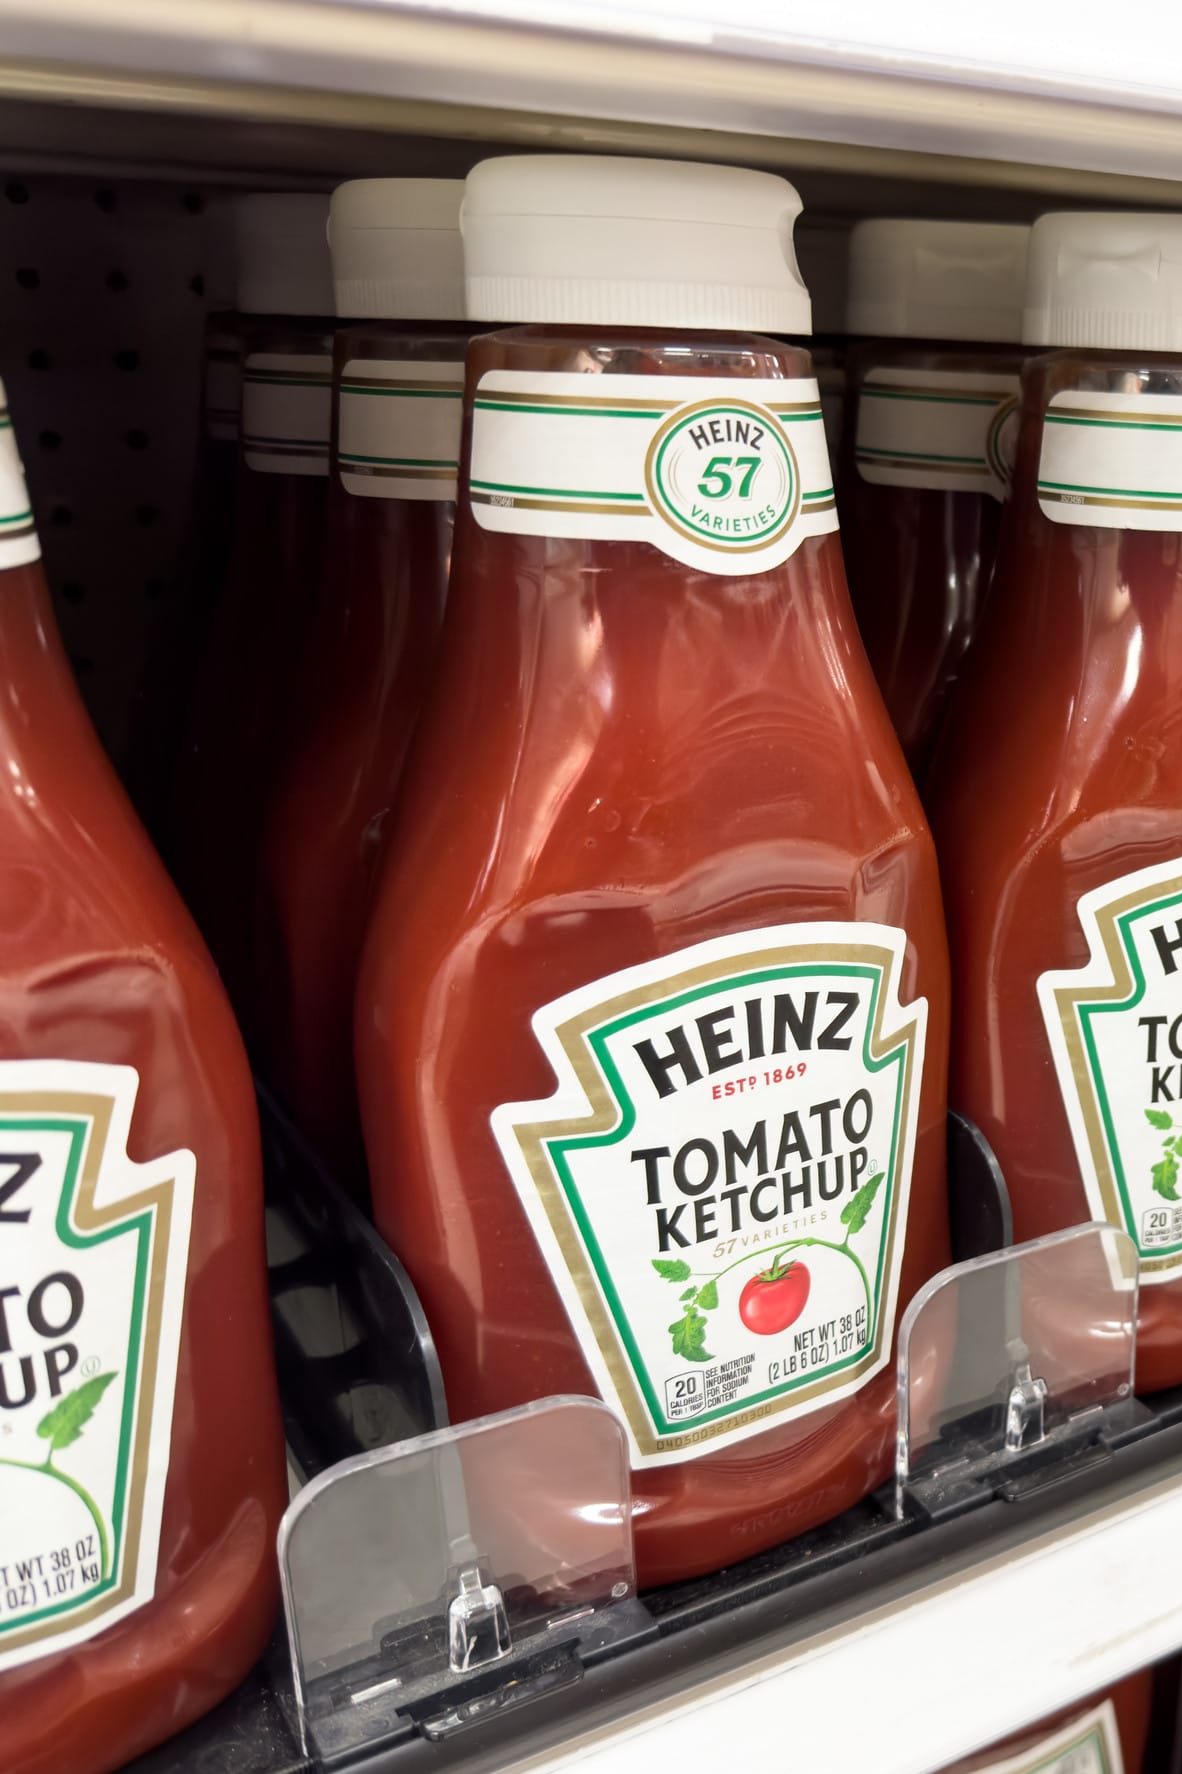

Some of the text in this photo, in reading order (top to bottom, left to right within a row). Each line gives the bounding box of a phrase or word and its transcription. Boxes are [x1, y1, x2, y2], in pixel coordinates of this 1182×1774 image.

[689, 419, 765, 450] HEINZ
[697, 456, 763, 499] 57
[690, 504, 777, 532] VARIETIES
[633, 991, 861, 1099] HEINZ
[764, 1062, 807, 1086] 1869
[631, 1088, 873, 1205] TOMATO
[656, 1146, 868, 1252] KETCHUP
[712, 1210, 829, 1259] 57 VARIETIES
[1150, 1212, 1167, 1228] 20
[794, 1305, 866, 1352] NET WT 38 OZ
[705, 1352, 756, 1379] SEE NUTRITION
[768, 1328, 866, 1384] (2 LB 6 OZ) 1.07 kg
[675, 1376, 696, 1398] 20
[706, 1364, 752, 1389] INFORMATION
[707, 1375, 749, 1399] FOR SODIUM
[670, 1393, 704, 1409] CALORIES
[707, 1390, 738, 1408] CONTENT
[15, 1555, 43, 1582] WT
[50, 1547, 71, 1571] 38
[75, 1534, 95, 1561] OZ
[7, 1563, 99, 1609] OZ) 1.07 kg
